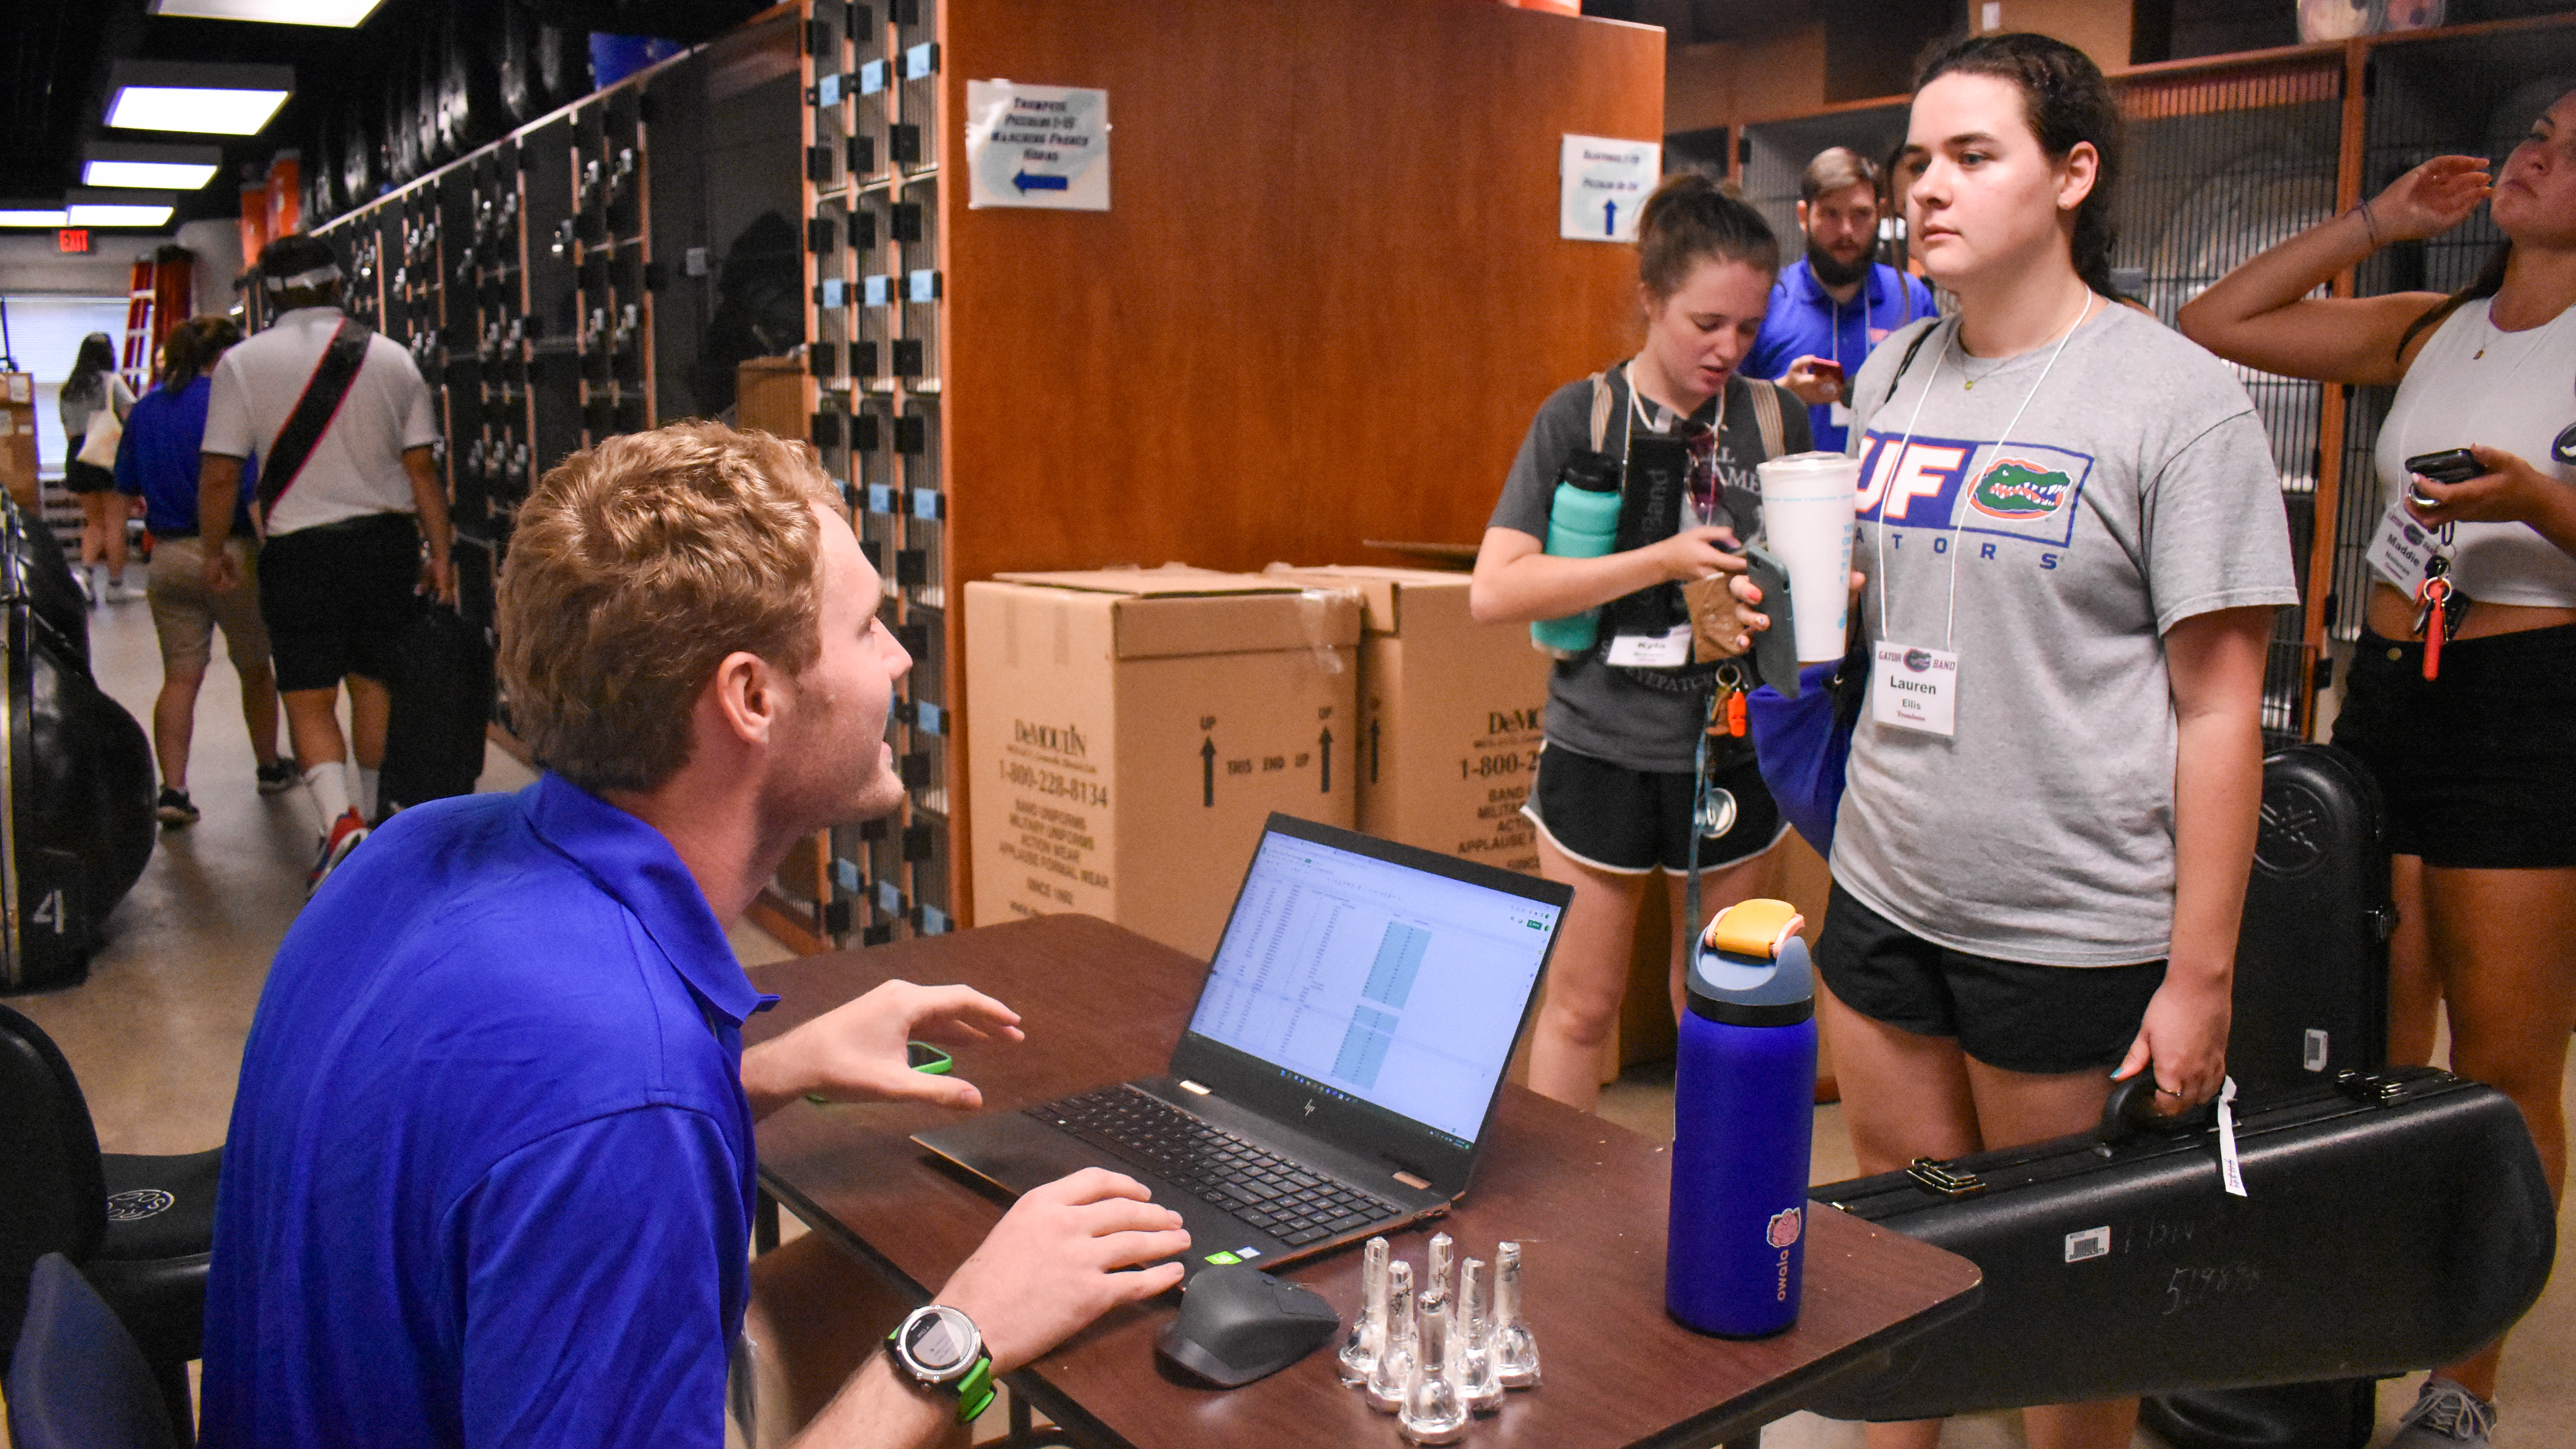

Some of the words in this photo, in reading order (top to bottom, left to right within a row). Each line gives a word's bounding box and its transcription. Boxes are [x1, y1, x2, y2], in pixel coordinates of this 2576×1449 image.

[59, 230, 88, 252] EXIT
[2386, 534, 2420, 566] Maddie
[1878, 650, 1902, 663] GATOR
[1932, 659, 1956, 671] BAND
[1890, 675, 1937, 695] Lauren
[1902, 698, 1921, 710] Ellis
[1200, 714, 1217, 731] UP
[1227, 759, 1253, 776] THIS
[1262, 755, 1285, 772] END
[1295, 753, 1310, 768] UP
[1488, 786, 1525, 803] BAND
[32, 889, 64, 935] 4
[1776, 1249, 1791, 1302] owala
